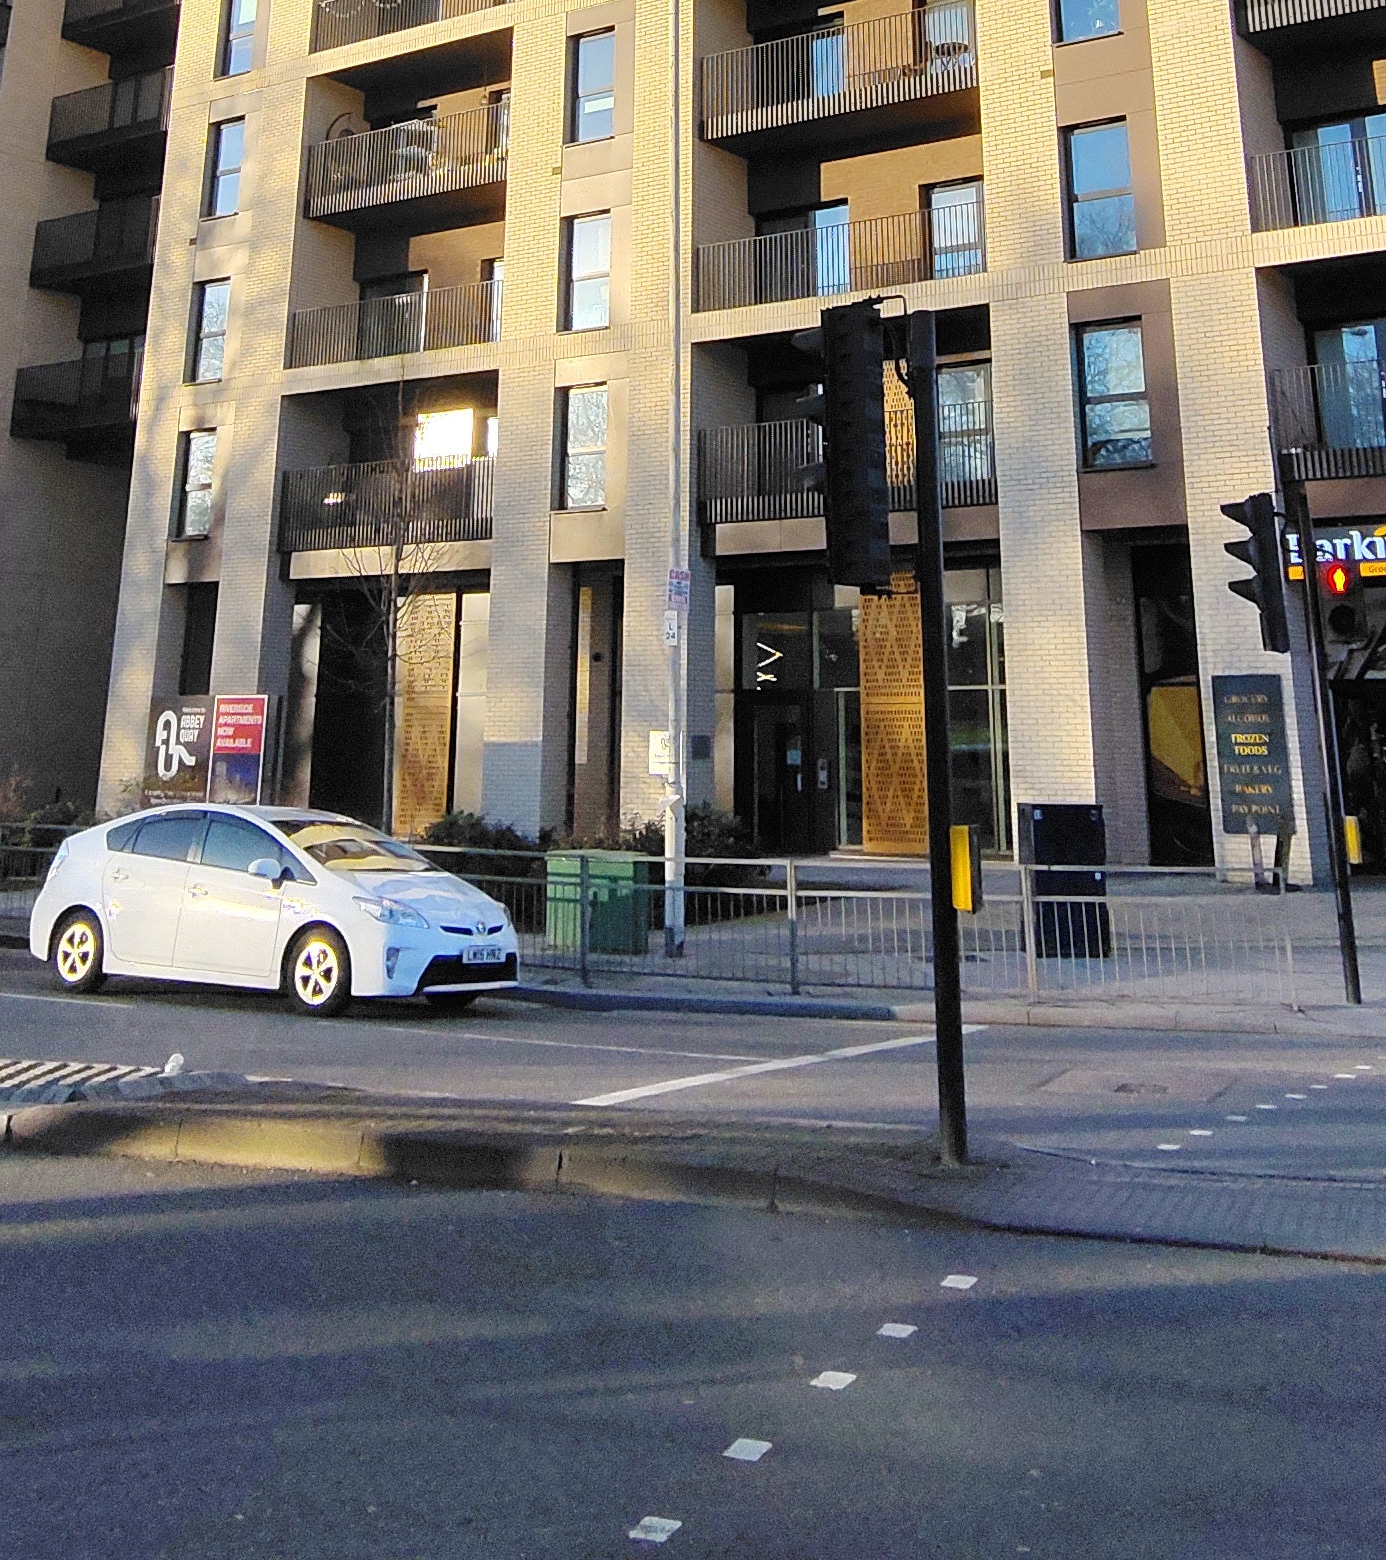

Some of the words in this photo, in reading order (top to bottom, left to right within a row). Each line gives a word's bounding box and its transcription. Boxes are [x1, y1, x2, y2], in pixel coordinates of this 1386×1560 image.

[665, 632, 676, 640] 24
[1223, 694, 1269, 704] GROCERY
[180, 714, 205, 729] ABBEY
[1227, 713, 1270, 724] ALCOHOL
[179, 728, 200, 743] QUAY
[1230, 733, 1270, 744] FROZEN
[1233, 745, 1269, 756] FOODS
[1234, 784, 1274, 794] BAKERY
